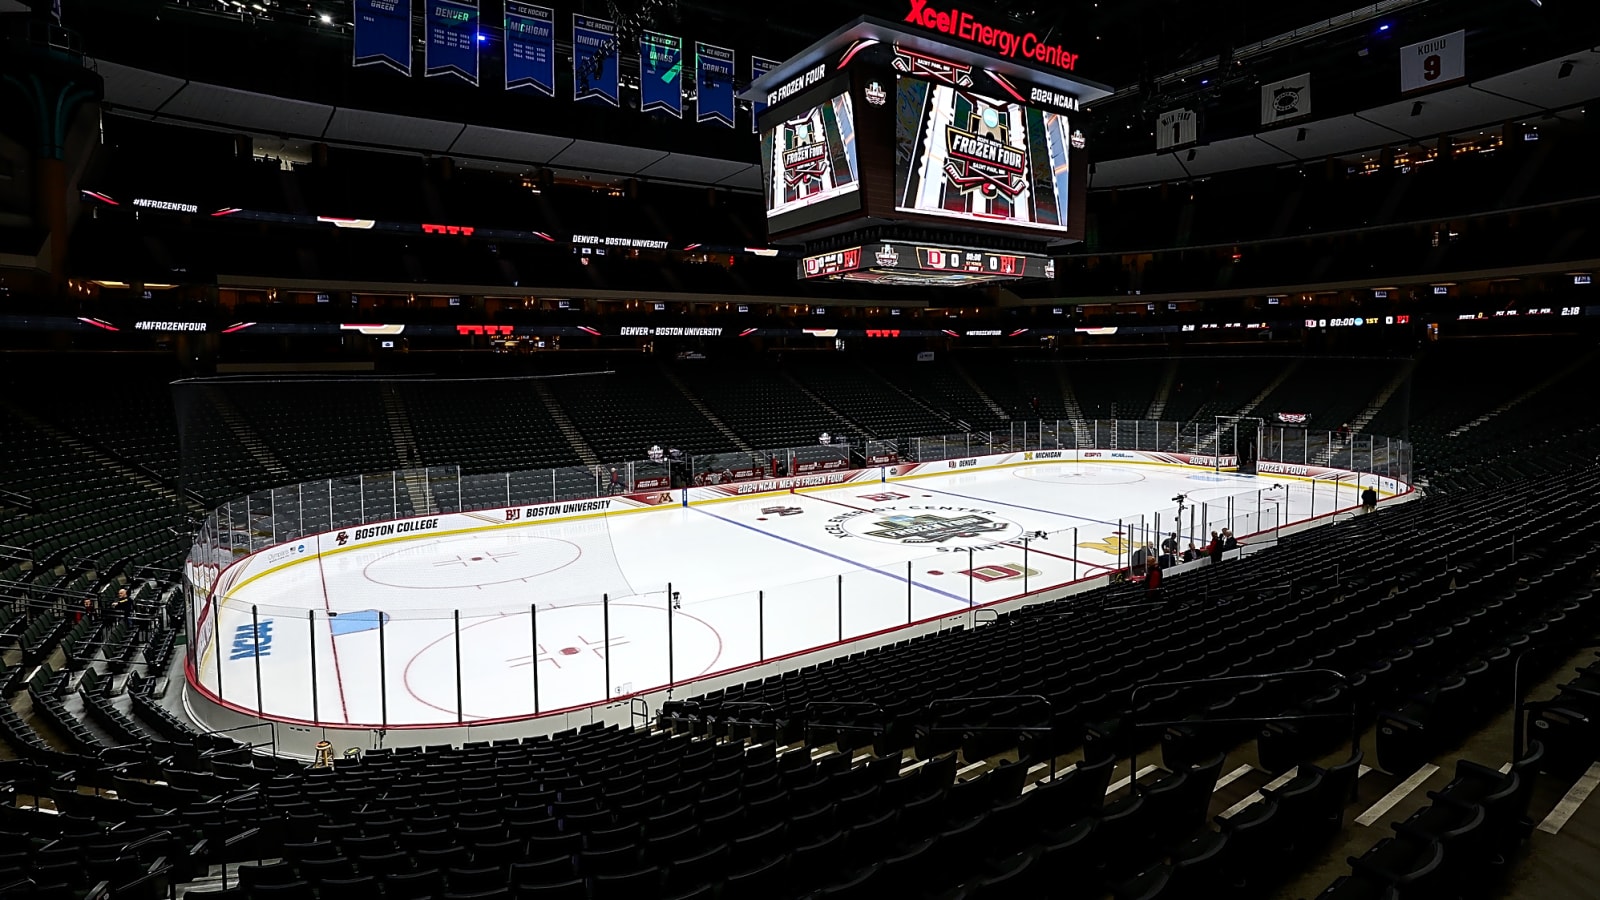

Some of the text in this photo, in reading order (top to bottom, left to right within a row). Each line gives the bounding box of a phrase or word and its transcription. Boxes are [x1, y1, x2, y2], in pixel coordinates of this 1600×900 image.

[435, 6, 469, 22] DENVER
[518, 6, 549, 18] ICE HOCKEY
[510, 21, 549, 37] MICHIGAN
[586, 20, 595, 28] ICE
[577, 34, 600, 47] UNION
[905, 0, 1079, 70] Xcel Energy Center
[1418, 39, 1446, 56] KOIVU
[650, 51, 673, 63] UMASS
[1424, 54, 1441, 81] 9
[778, 75, 804, 102] FROZEN
[805, 64, 825, 86] FOUR
[1031, 87, 1052, 105] 2024
[1053, 92, 1073, 110] NCAA
[1173, 122, 1180, 144] 1
[786, 148, 808, 164] FROZEN
[809, 146, 823, 158] FOUR
[953, 135, 1021, 168] FROZEN FOUR
[132, 198, 198, 213] #MFROZENFOUR
[572, 234, 599, 244] DENVER
[605, 237, 632, 246] BOSTON
[632, 238, 669, 249] UNIVERSITY
[951, 253, 959, 267] 0
[990, 256, 998, 270] 0
[1561, 306, 1580, 316] 2:18
[134, 321, 207, 331] #MFROZENFOUR
[1319, 319, 1326, 327] 0
[1386, 316, 1394, 324] 0
[620, 326, 649, 336] DENVER
[655, 327, 684, 336] BOSTON
[684, 327, 723, 336] UNIVERSITY
[959, 459, 977, 468] DENVER
[1189, 456, 1208, 466] 2024
[1285, 466, 1308, 476] FOUR
[738, 474, 844, 494] 2024 NCAA MEN'S FROZEN FOUR
[526, 505, 560, 518] BOSTON
[562, 500, 611, 514] UNIVERSITY
[908, 505, 997, 515] CENTER
[355, 524, 394, 540] BOSTON
[396, 518, 438, 533] COLLEGE
[229, 618, 273, 660] NCAA
